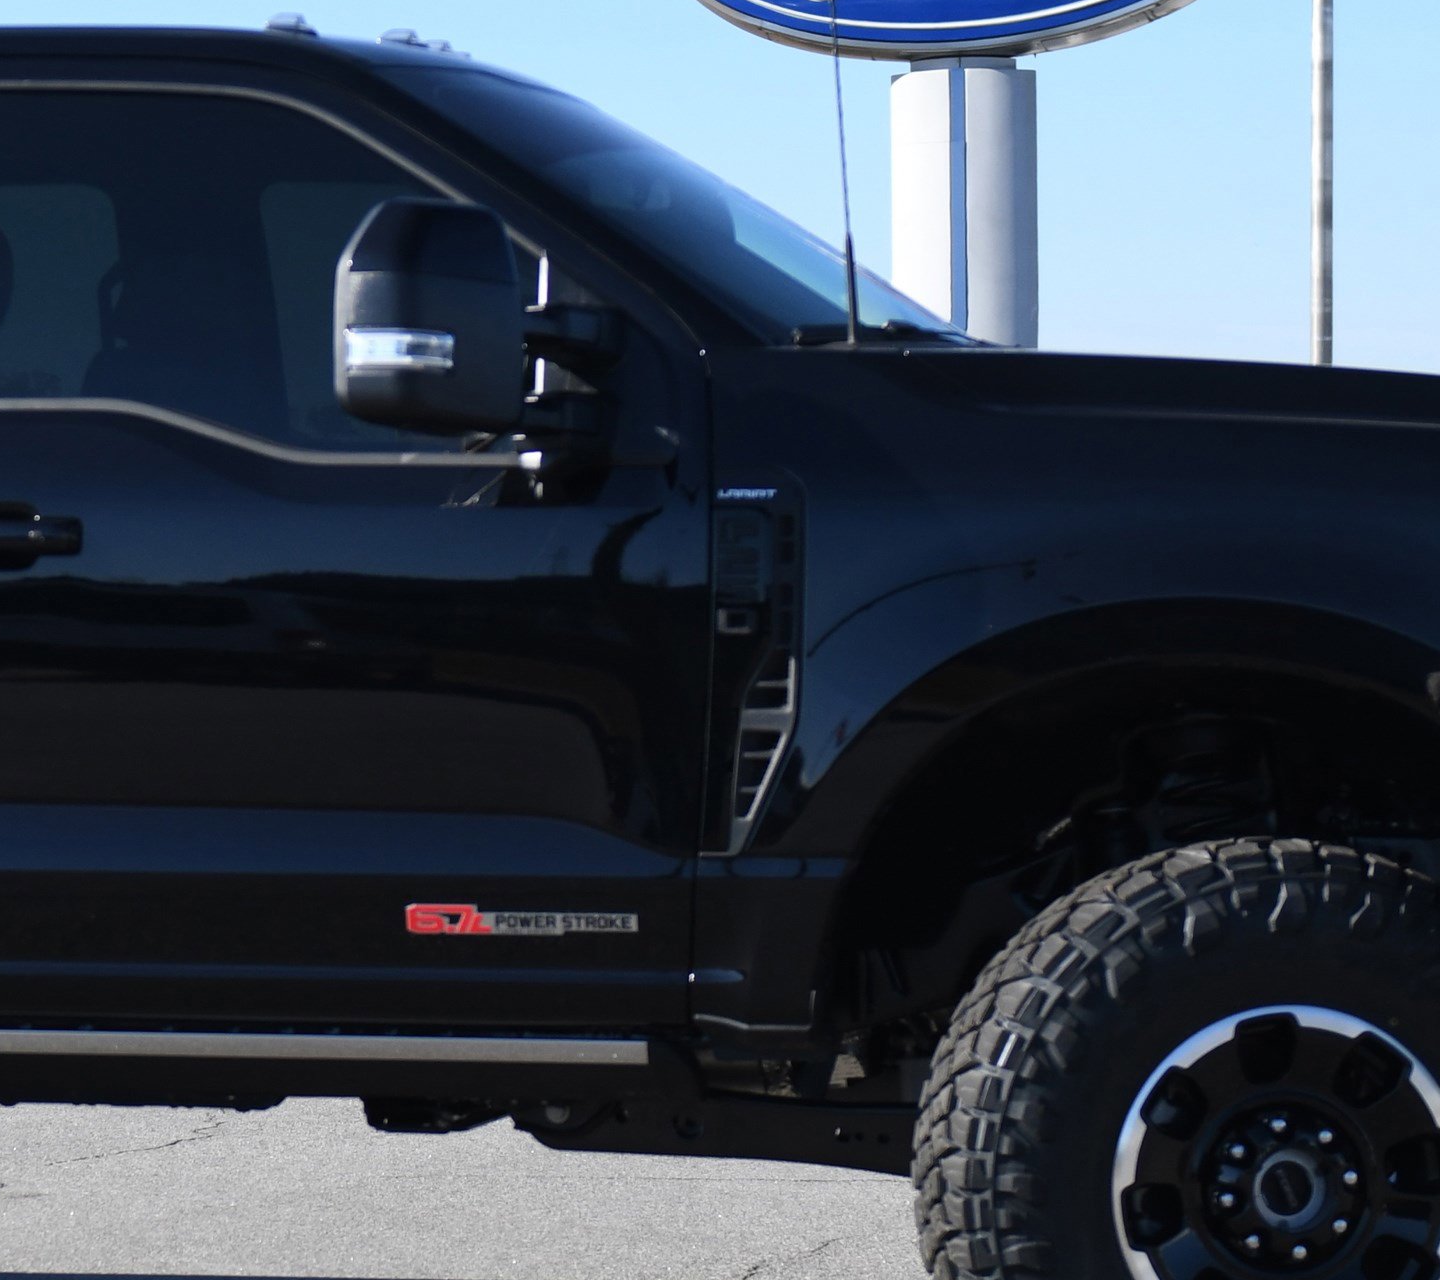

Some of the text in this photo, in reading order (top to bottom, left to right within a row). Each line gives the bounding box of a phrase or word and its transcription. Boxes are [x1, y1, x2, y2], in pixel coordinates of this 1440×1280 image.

[405, 904, 634, 934] 6.7L POWER STROKE
